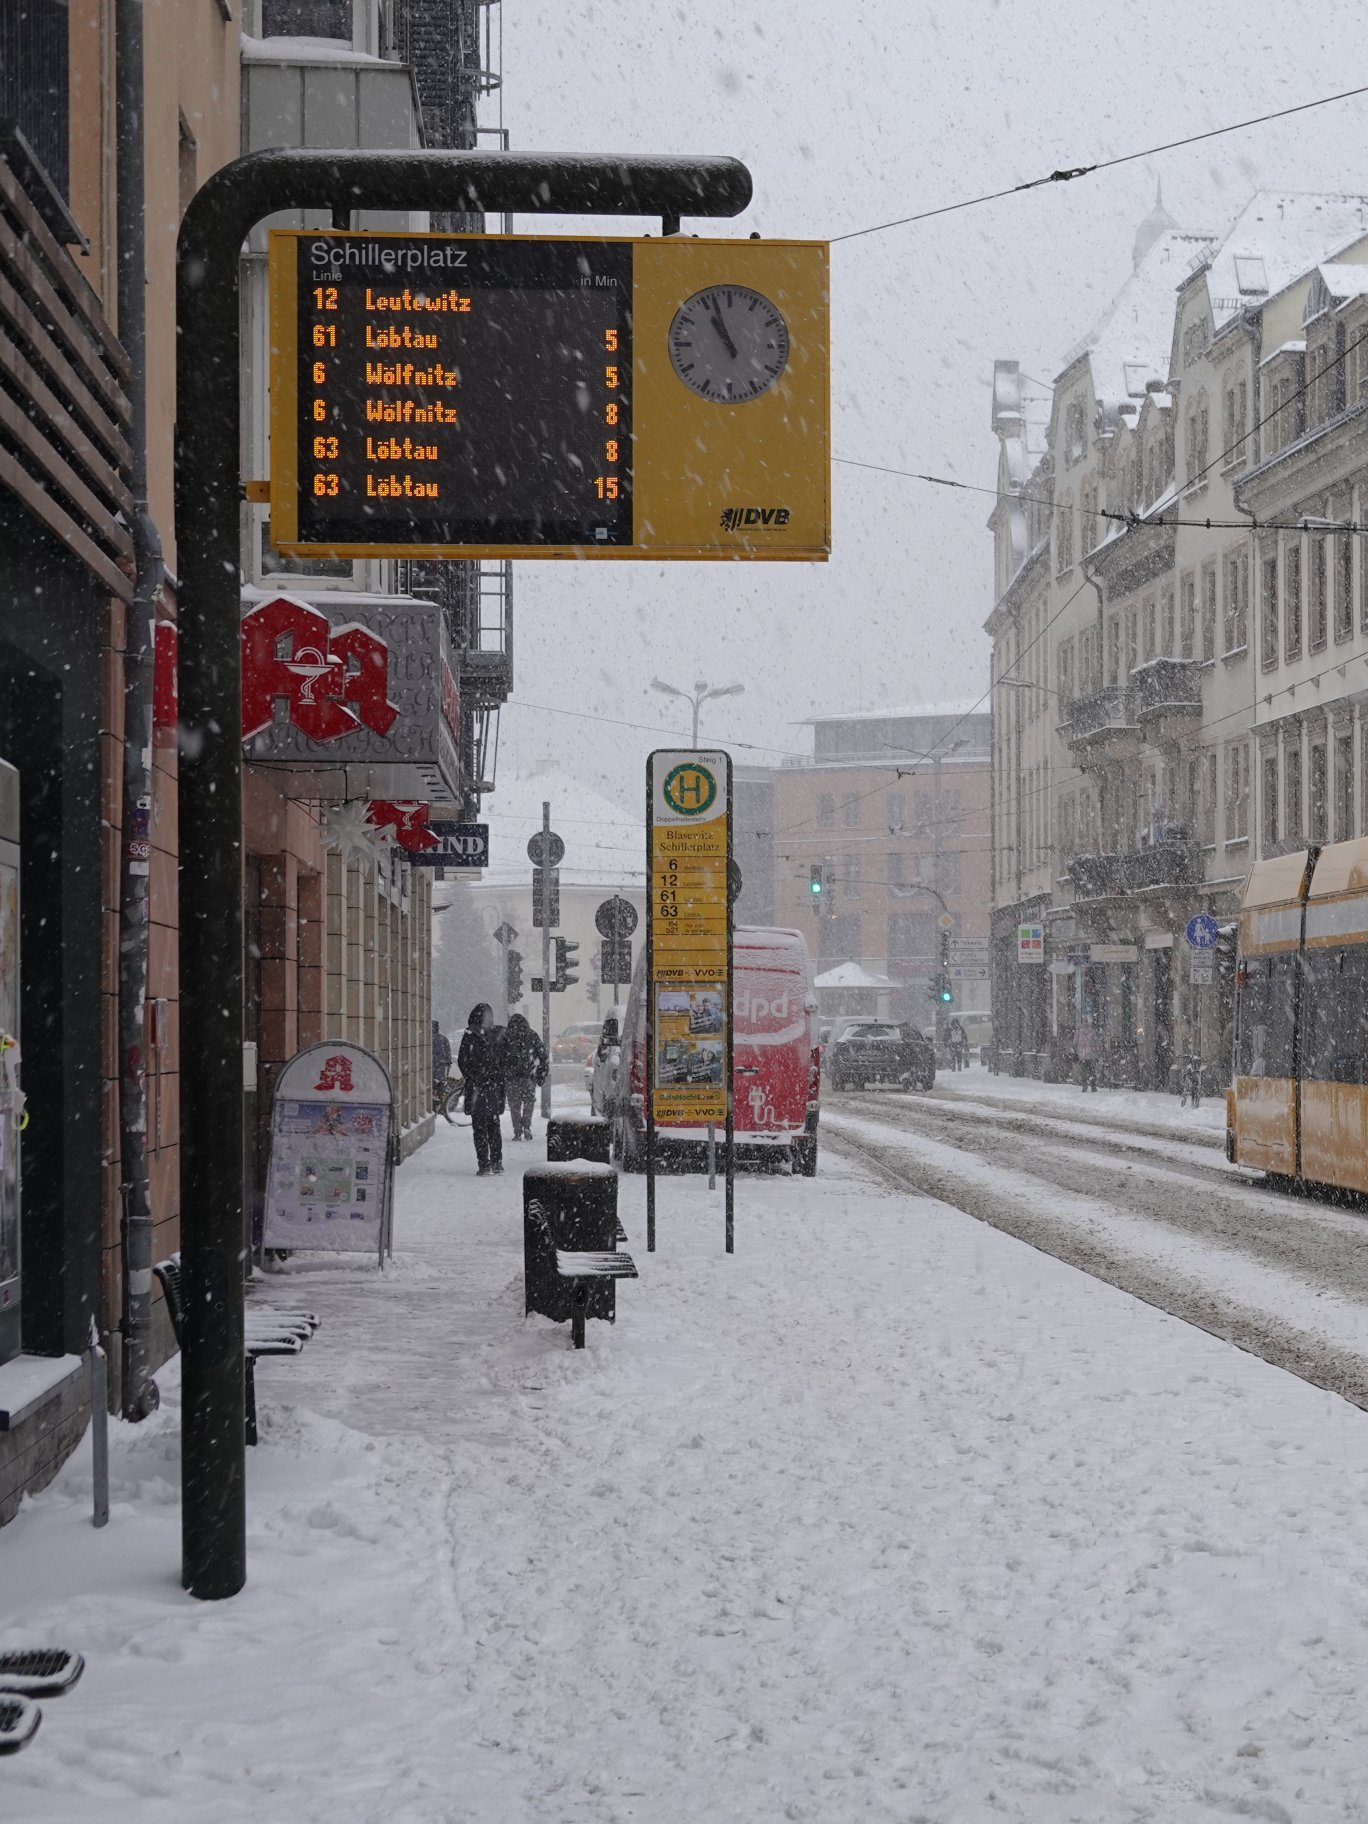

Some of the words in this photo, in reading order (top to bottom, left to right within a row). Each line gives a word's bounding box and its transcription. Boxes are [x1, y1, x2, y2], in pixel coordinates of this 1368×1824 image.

[311, 242, 467, 271] Schillerplatz
[313, 270, 342, 281] Linie
[580, 275, 591, 286] in
[595, 275, 617, 286] Min
[313, 288, 338, 309] 12
[366, 289, 471, 311] Leutewitz
[313, 325, 336, 346] 61
[366, 326, 437, 348] Löbtau
[606, 330, 617, 351] 5
[313, 362, 326, 383] 6
[366, 363, 456, 386] Wölfnitz
[606, 367, 617, 388] 5
[313, 399, 326, 421] 6
[366, 400, 456, 422] Wölfnitz
[606, 404, 618, 425] 8
[313, 437, 338, 459] 63
[366, 438, 438, 460] Löbtau
[606, 440, 618, 461] 8
[314, 474, 339, 496] 63
[366, 475, 438, 497] Löbtau
[594, 477, 618, 499] 15
[744, 508, 790, 525] DVB
[698, 756, 716, 764] Steig
[667, 830, 714, 840] Blasewitz
[419, 837, 484, 854] IND
[659, 842, 721, 854] Schillerplatz
[669, 859, 678, 871] 6
[661, 875, 678, 886] 12
[661, 890, 676, 902] 61
[661, 905, 678, 917] 63
